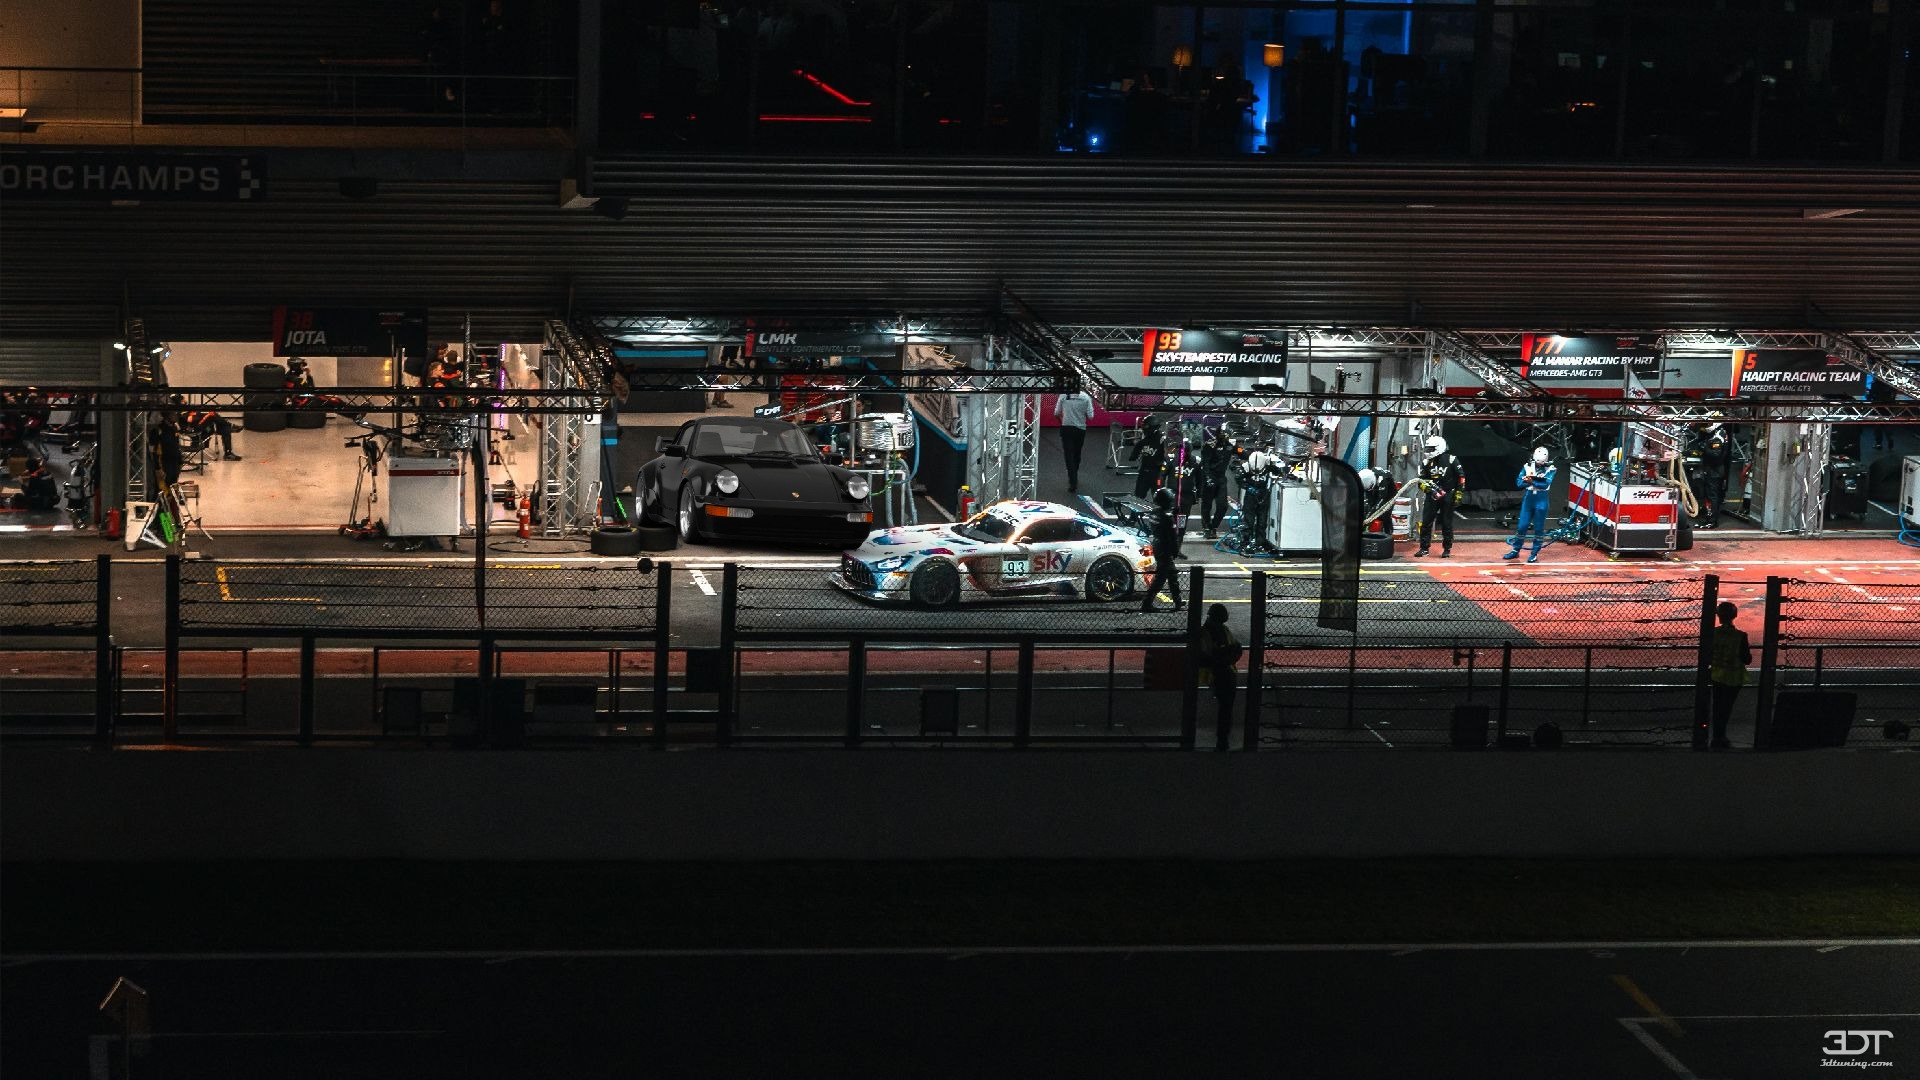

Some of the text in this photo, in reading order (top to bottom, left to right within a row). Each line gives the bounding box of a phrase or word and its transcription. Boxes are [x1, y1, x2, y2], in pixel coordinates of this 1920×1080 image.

[0, 164, 220, 191] ORCHAMPS
[284, 330, 327, 348] JOTA
[1158, 332, 1182, 350] 93
[1535, 337, 1567, 354] 777
[1238, 353, 1282, 364] RACING
[1531, 357, 1545, 365] AL
[1583, 357, 1621, 365] RACING
[1621, 357, 1633, 365] BY
[1633, 356, 1655, 365] HRT
[1744, 353, 1758, 370] 5
[1529, 369, 1603, 377] MERCEDES-AMG GT3
[1742, 371, 1861, 382] HAUPT RACING TEAM
[1008, 422, 1018, 435] 5
[1033, 549, 1073, 573] sky
[1008, 562, 1025, 577] 93
